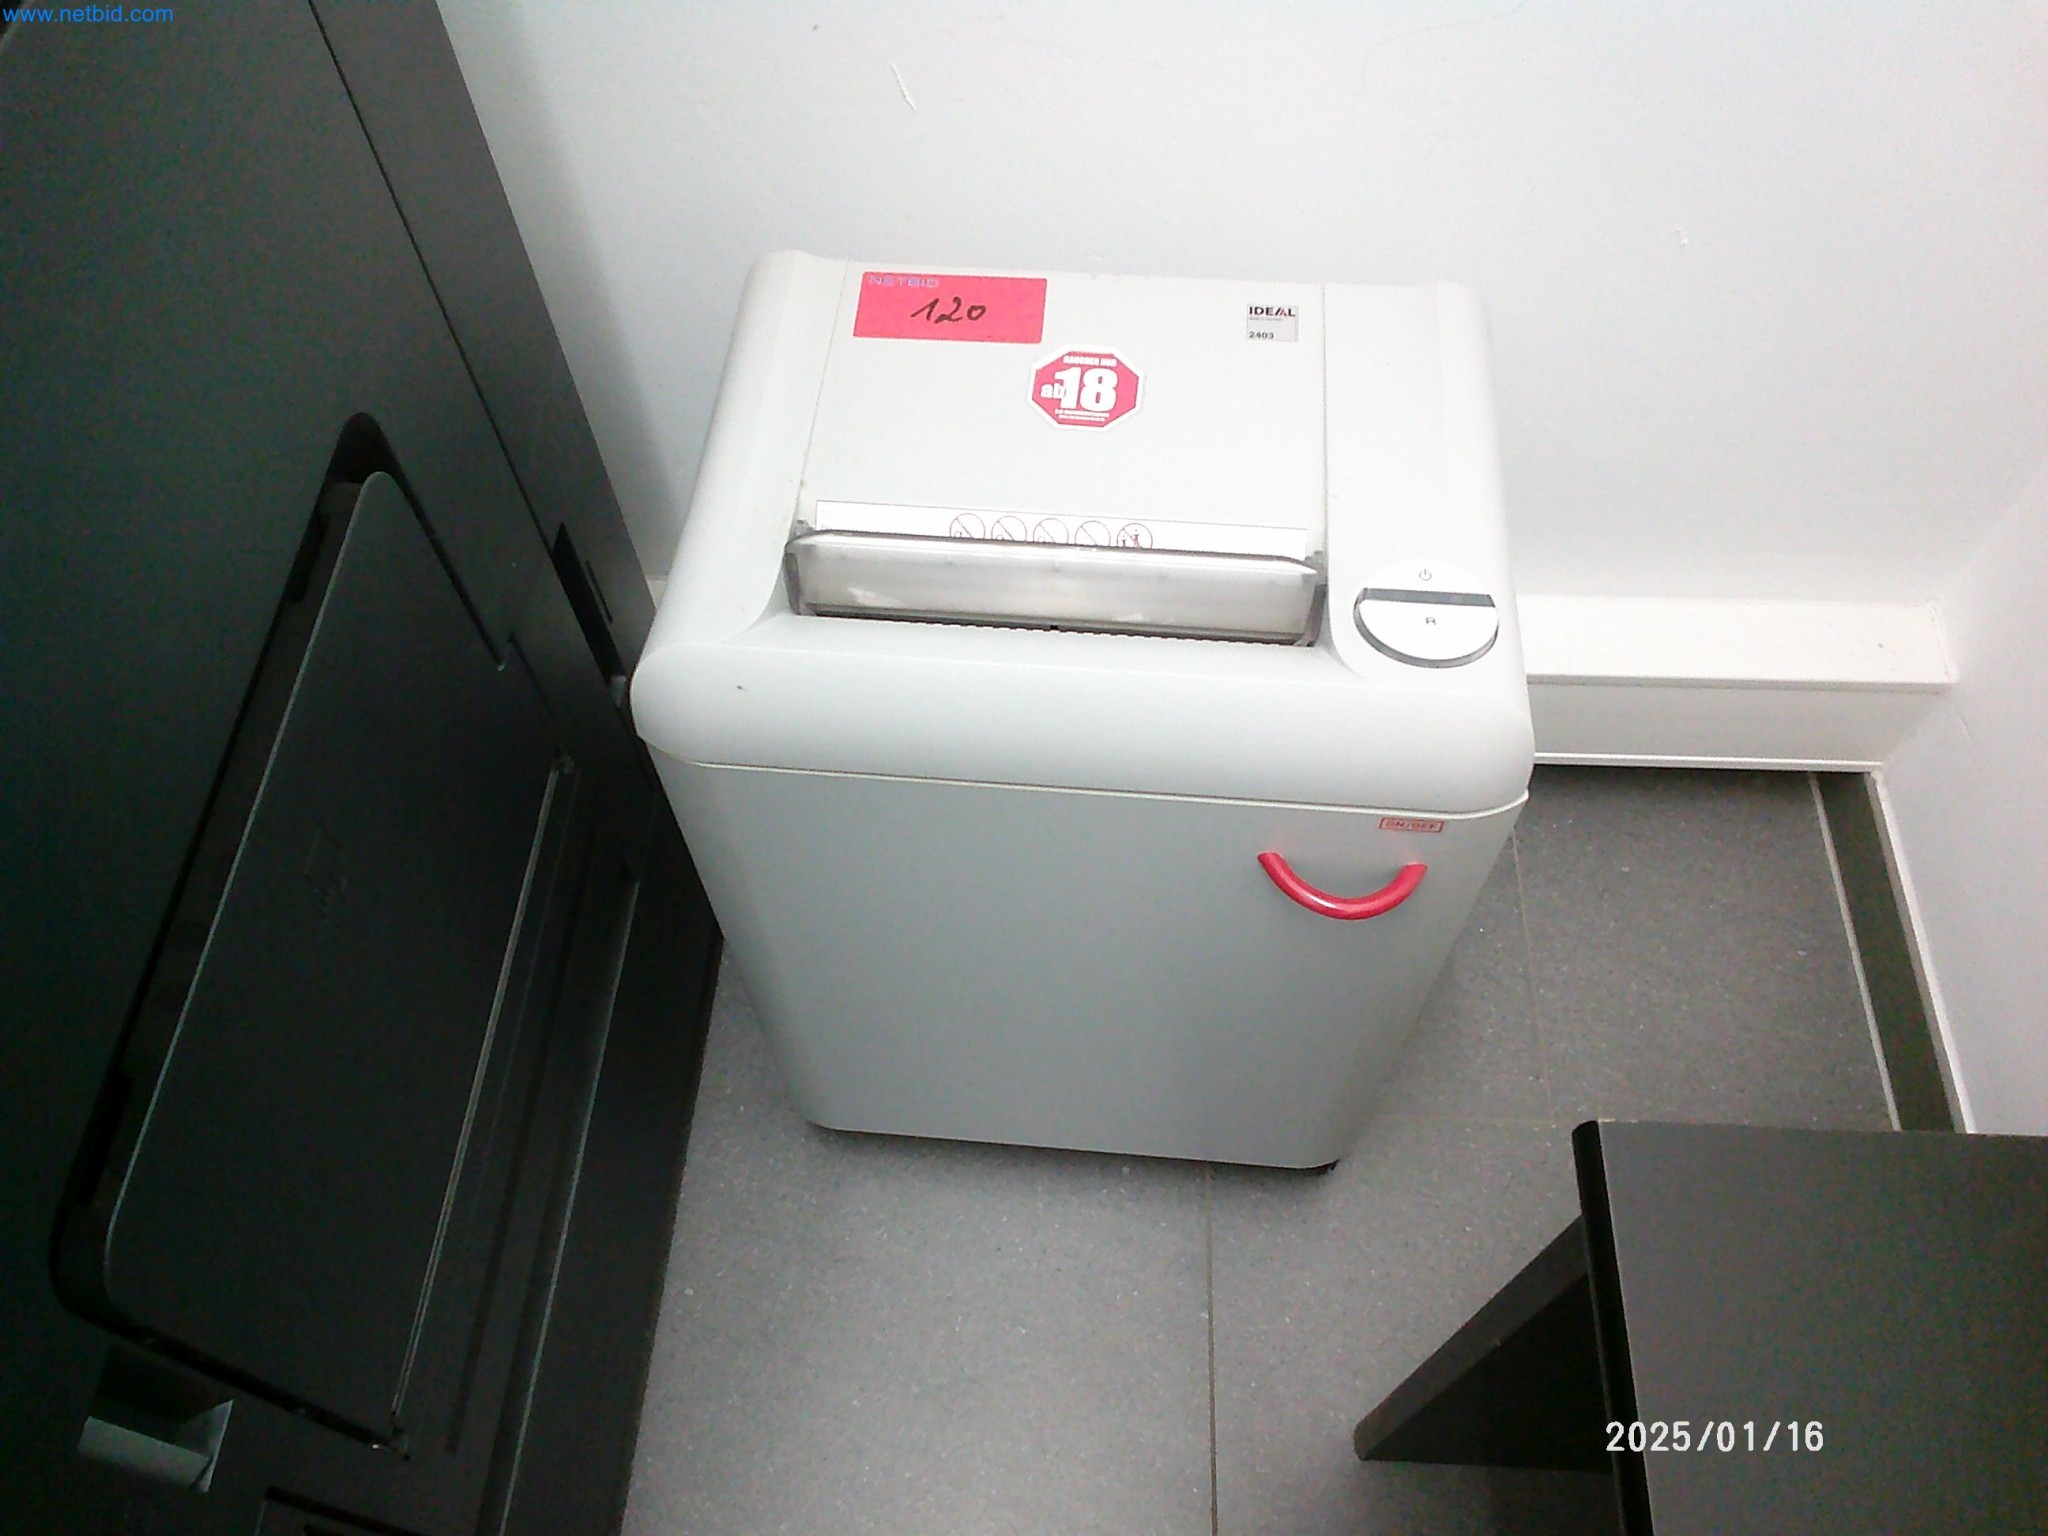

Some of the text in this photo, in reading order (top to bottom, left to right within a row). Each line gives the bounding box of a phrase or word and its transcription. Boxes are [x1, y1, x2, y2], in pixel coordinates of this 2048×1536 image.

[910, 296, 987, 324] 120
[1249, 306, 1296, 317] IDEAL
[1040, 366, 1119, 412] ab 18
[1425, 617, 1437, 625] R
